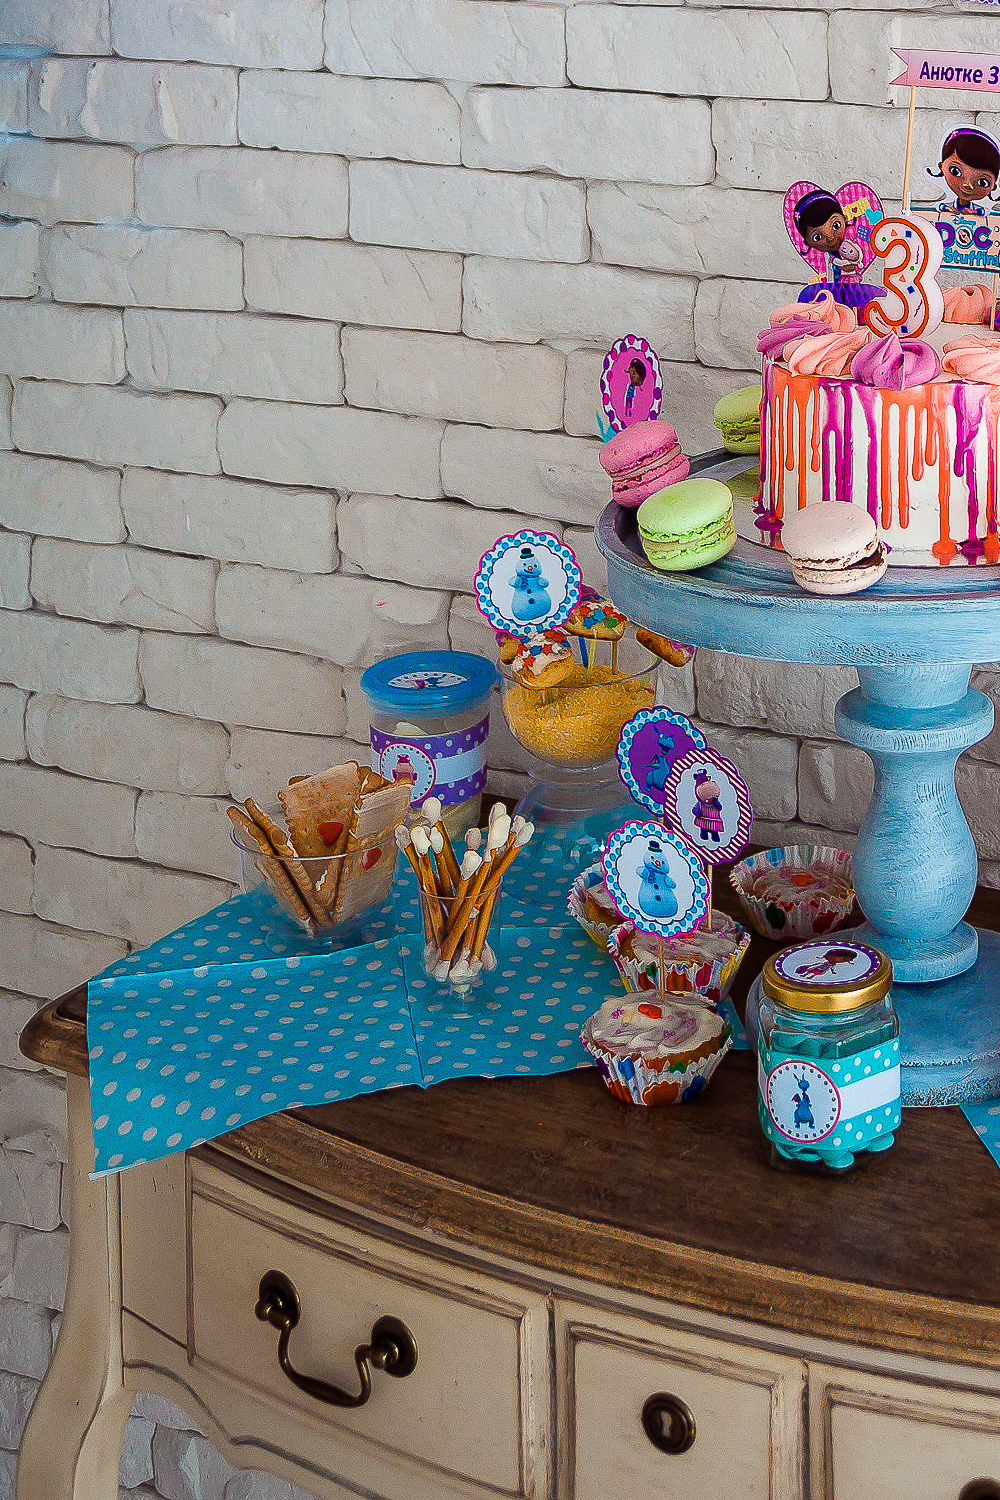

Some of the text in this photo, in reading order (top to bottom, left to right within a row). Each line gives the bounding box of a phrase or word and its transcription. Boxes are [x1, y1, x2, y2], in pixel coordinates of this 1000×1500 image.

[919, 61, 983, 84] Анютке
[988, 65, 999, 84] 3
[865, 216, 935, 339] 3
